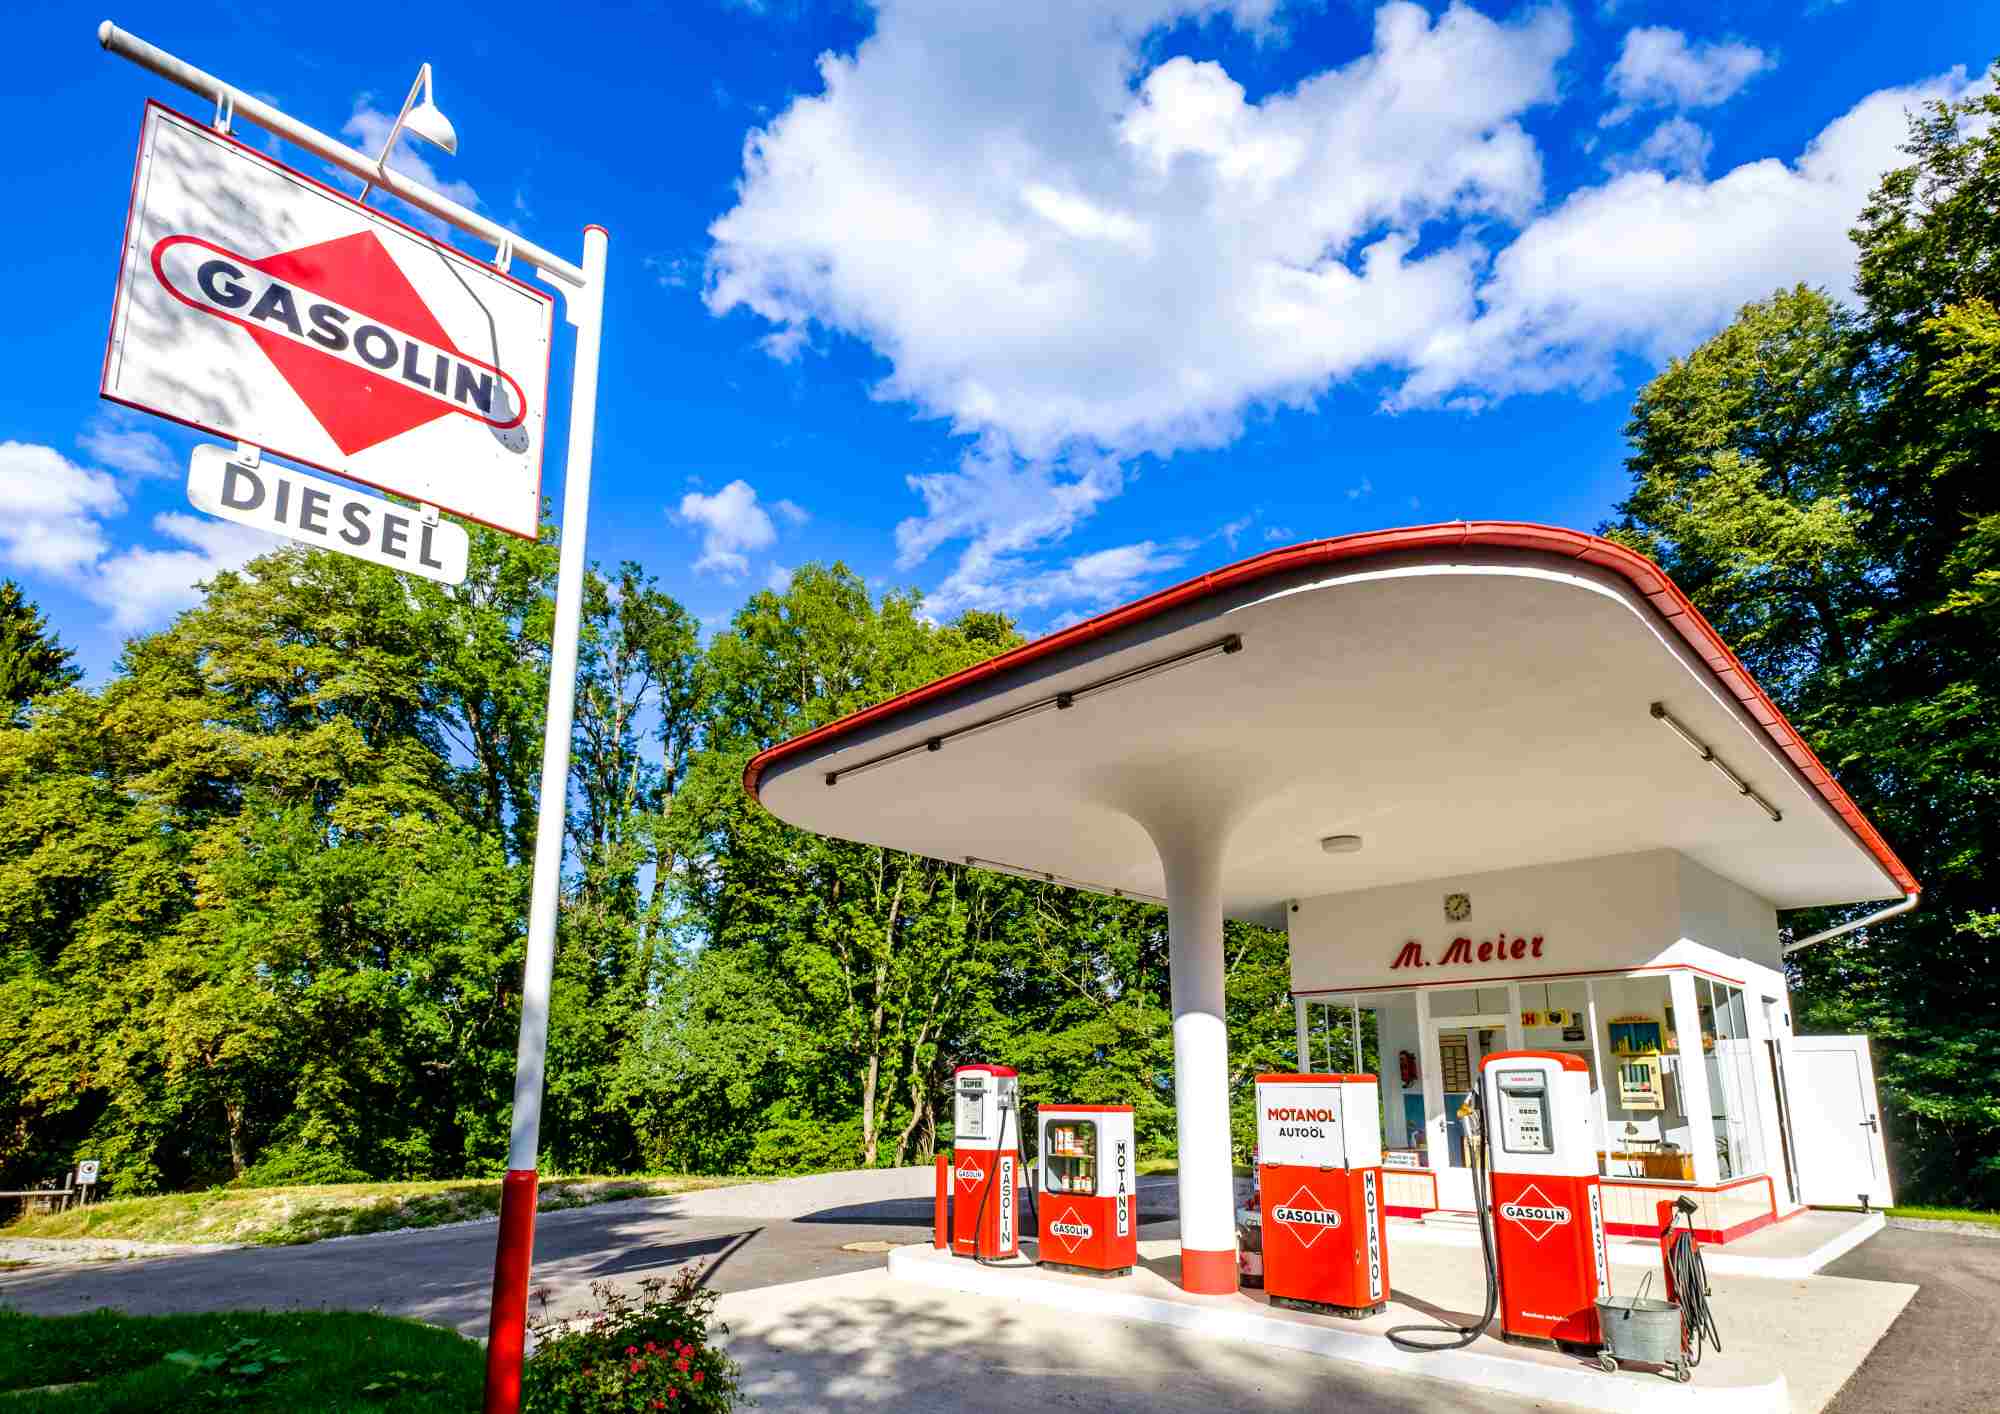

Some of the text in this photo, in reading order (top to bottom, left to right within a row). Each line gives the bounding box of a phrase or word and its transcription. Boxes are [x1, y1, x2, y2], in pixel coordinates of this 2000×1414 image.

[196, 260, 493, 414] GASOLIN
[220, 462, 443, 570] DIESEL
[1389, 933, 1545, 970] M. Meier
[1267, 1107, 1336, 1123] MOTANOL
[1279, 1126, 1326, 1139] AUTOÖL
[958, 1170, 982, 1178] GASOLIN
[1117, 1142, 1127, 1234] MOTANOL
[1002, 1161, 1011, 1244] GASOLIN
[1505, 1206, 1566, 1221] GASOLIN
[1053, 1223, 1089, 1236] GASOLIN
[1276, 1208, 1336, 1225] GASOLIN
[1365, 1172, 1380, 1297] MOTANOL
